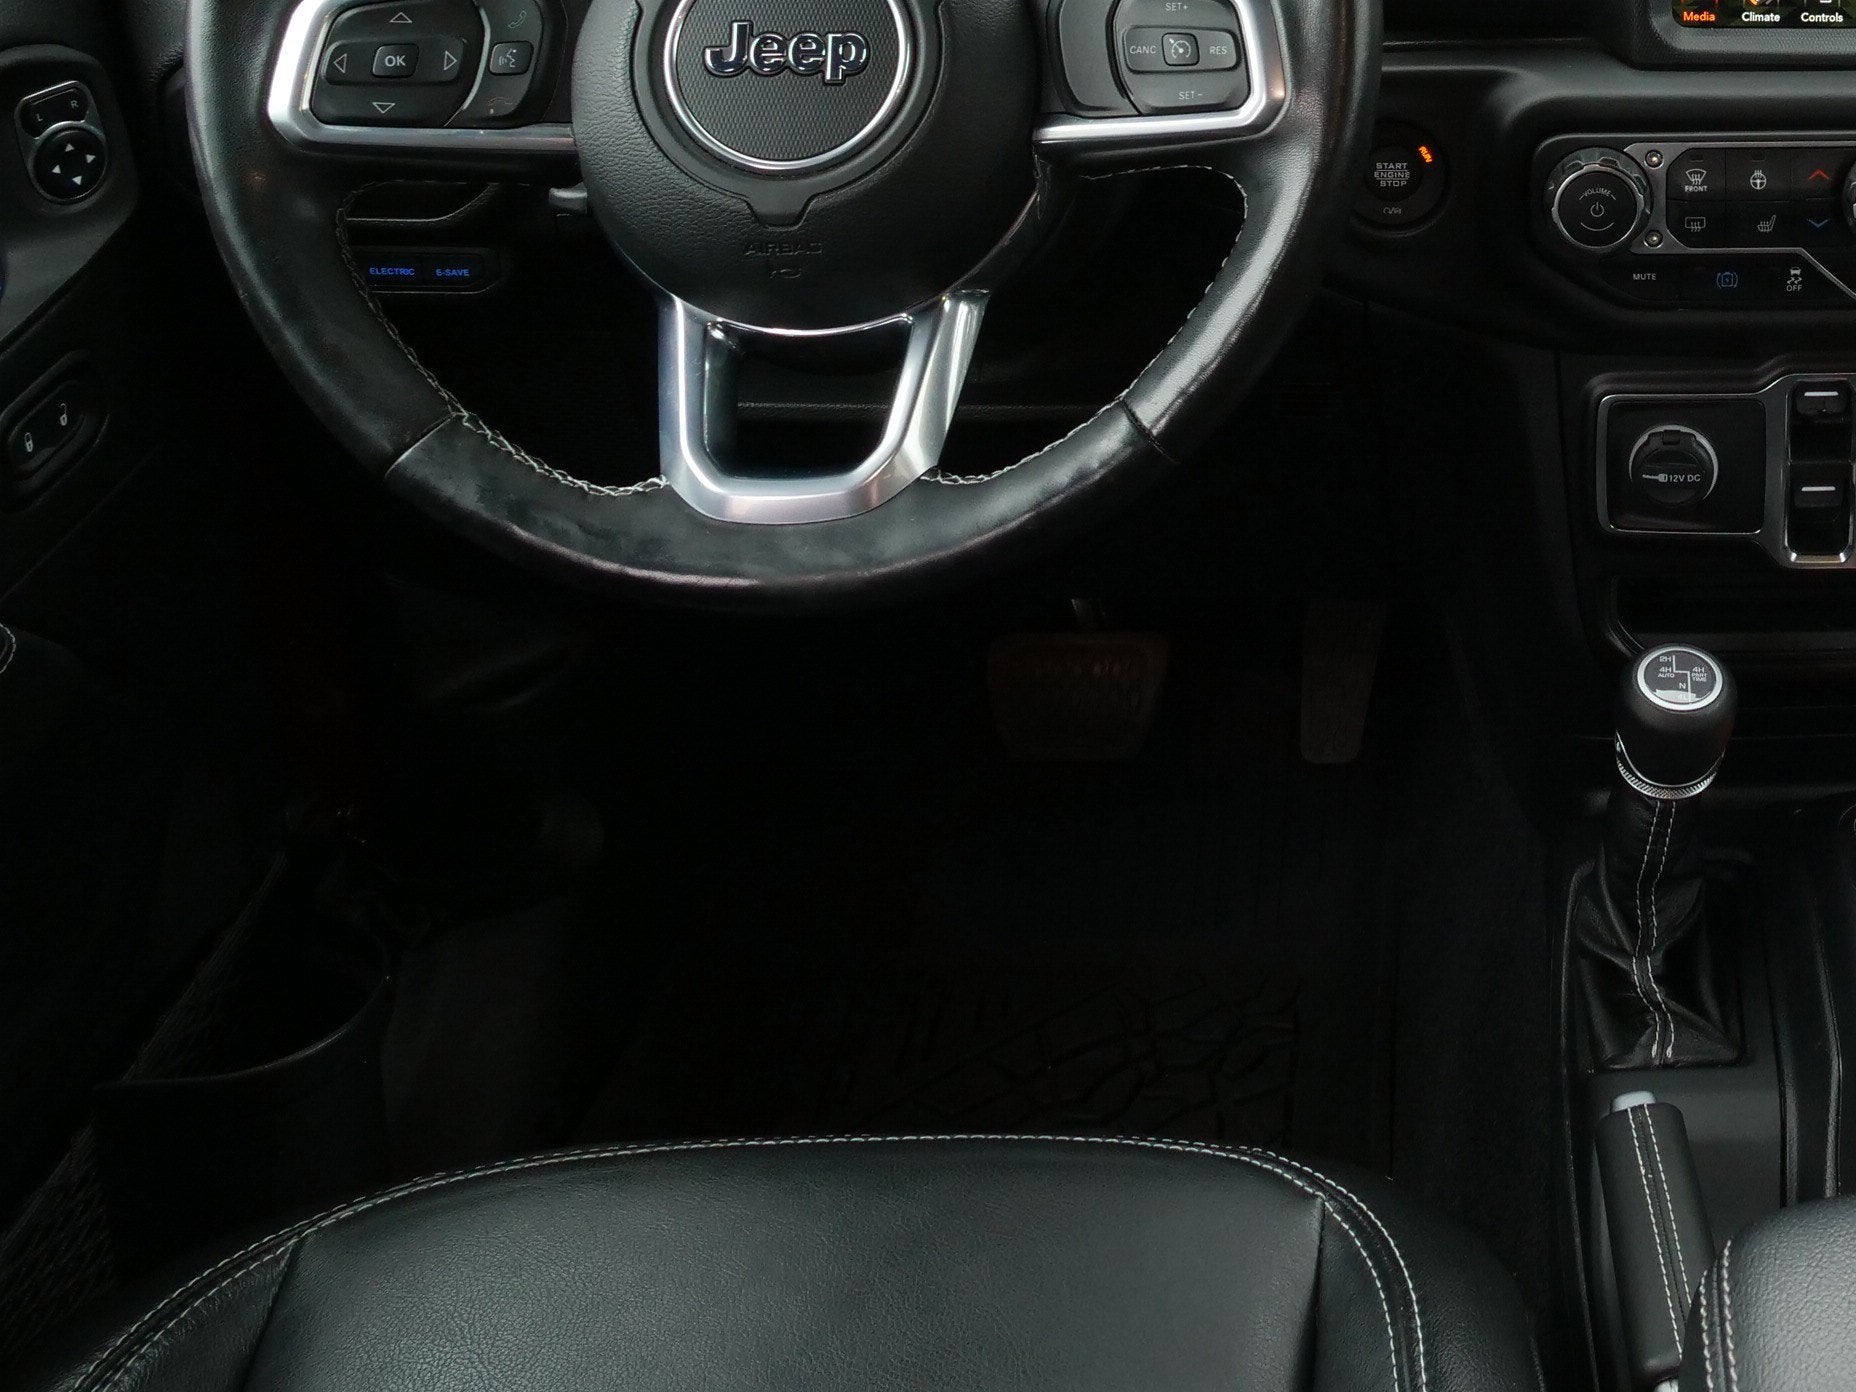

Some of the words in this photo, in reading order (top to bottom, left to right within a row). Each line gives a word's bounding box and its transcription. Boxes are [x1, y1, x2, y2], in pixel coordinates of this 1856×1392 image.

[1684, 11, 1715, 22] Media
[1741, 12, 1780, 22] Climate
[1800, 12, 1843, 22] Controls
[704, 20, 871, 86] Jeep
[1129, 45, 1157, 55] CANC
[1209, 45, 1228, 55] RES
[384, 54, 407, 68] OK
[70, 99, 80, 109] R
[1374, 171, 1411, 179] ENGINE
[1583, 188, 1612, 198] VOLUME
[1684, 185, 1708, 193] FRONT
[368, 267, 416, 277] ELECTRIC
[435, 267, 470, 277] E-SAVE
[1632, 272, 1657, 281] MUTE
[1786, 284, 1803, 293] OFF
[1668, 472, 1687, 483] 12V
[1688, 472, 1701, 482] DC
